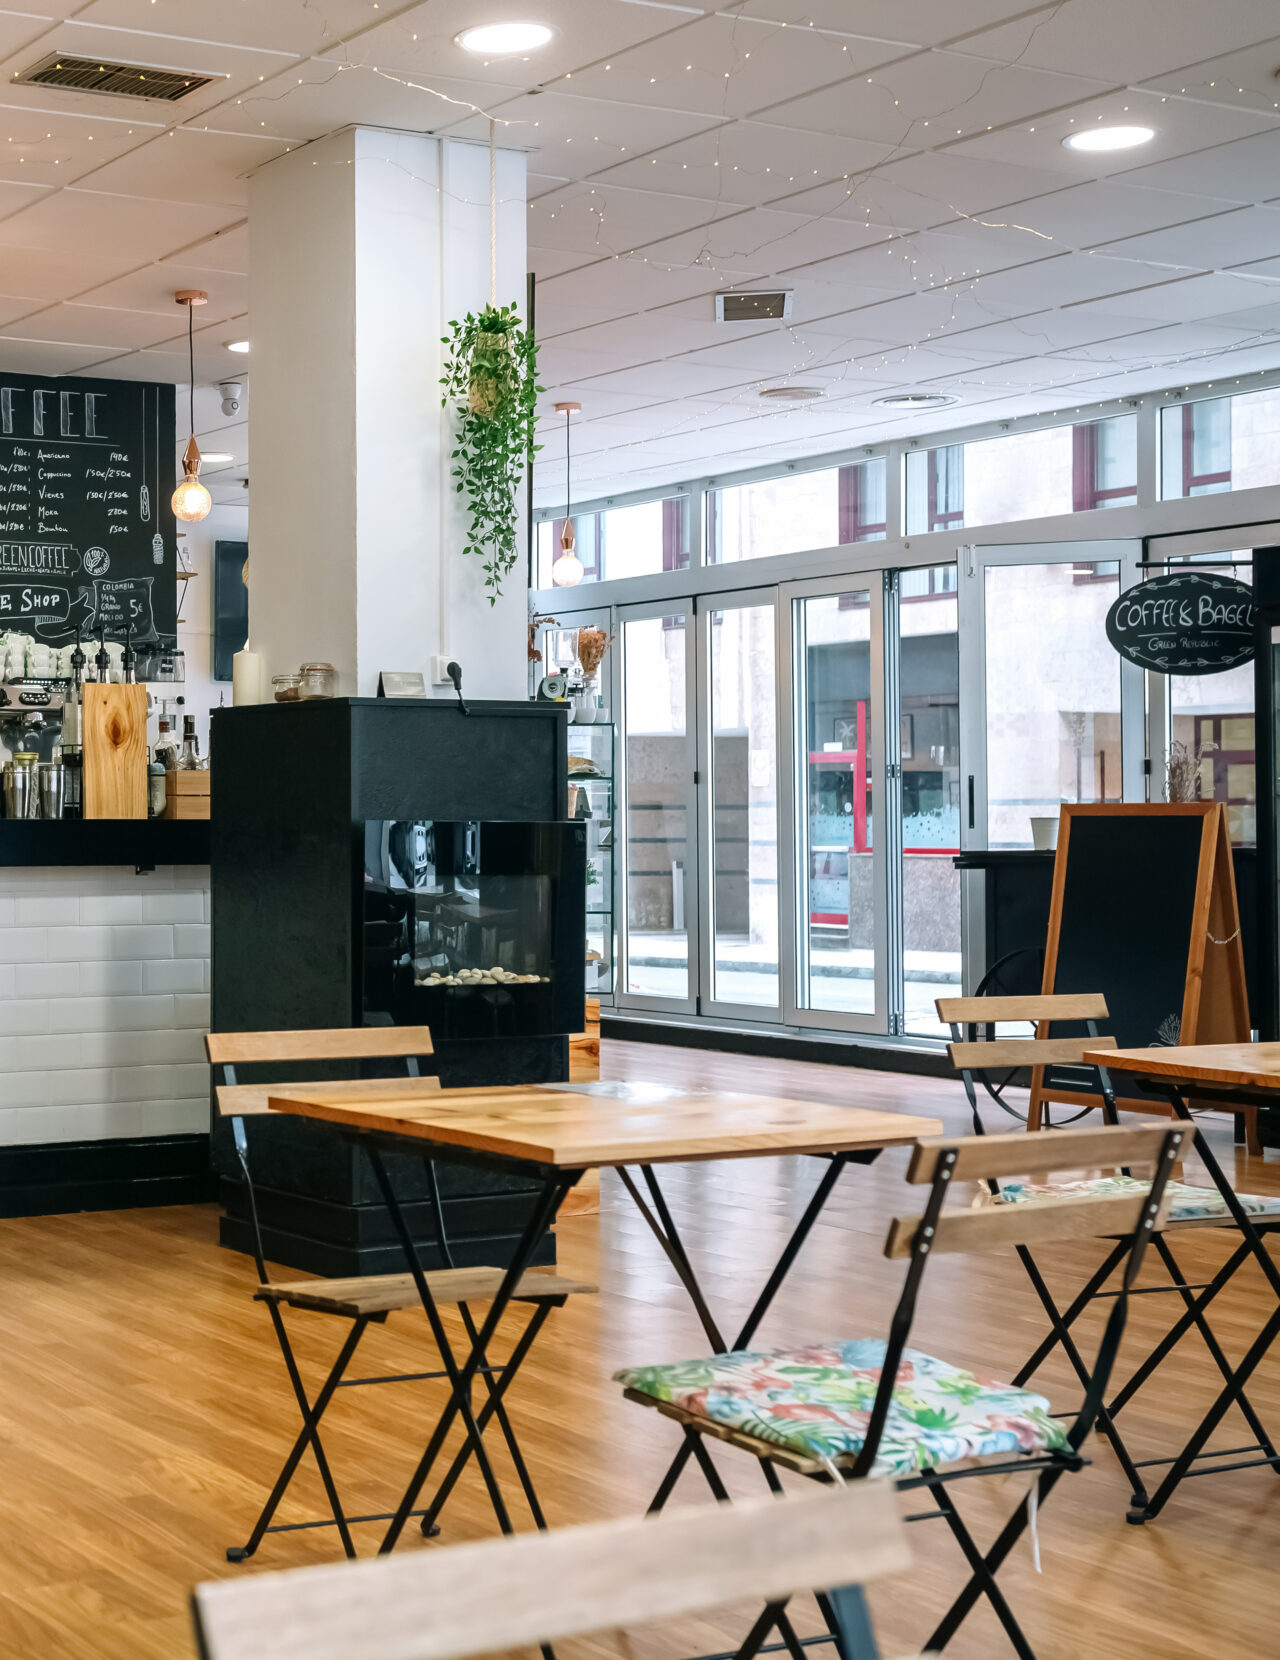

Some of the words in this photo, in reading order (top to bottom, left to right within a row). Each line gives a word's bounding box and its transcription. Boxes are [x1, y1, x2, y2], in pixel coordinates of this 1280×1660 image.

[102, 582, 134, 590] COLOMBIA
[21, 589, 60, 613] SHOP
[1115, 599, 1178, 631] COFFEE
[1179, 600, 1194, 626] &
[1198, 595, 1258, 627] BAGEL
